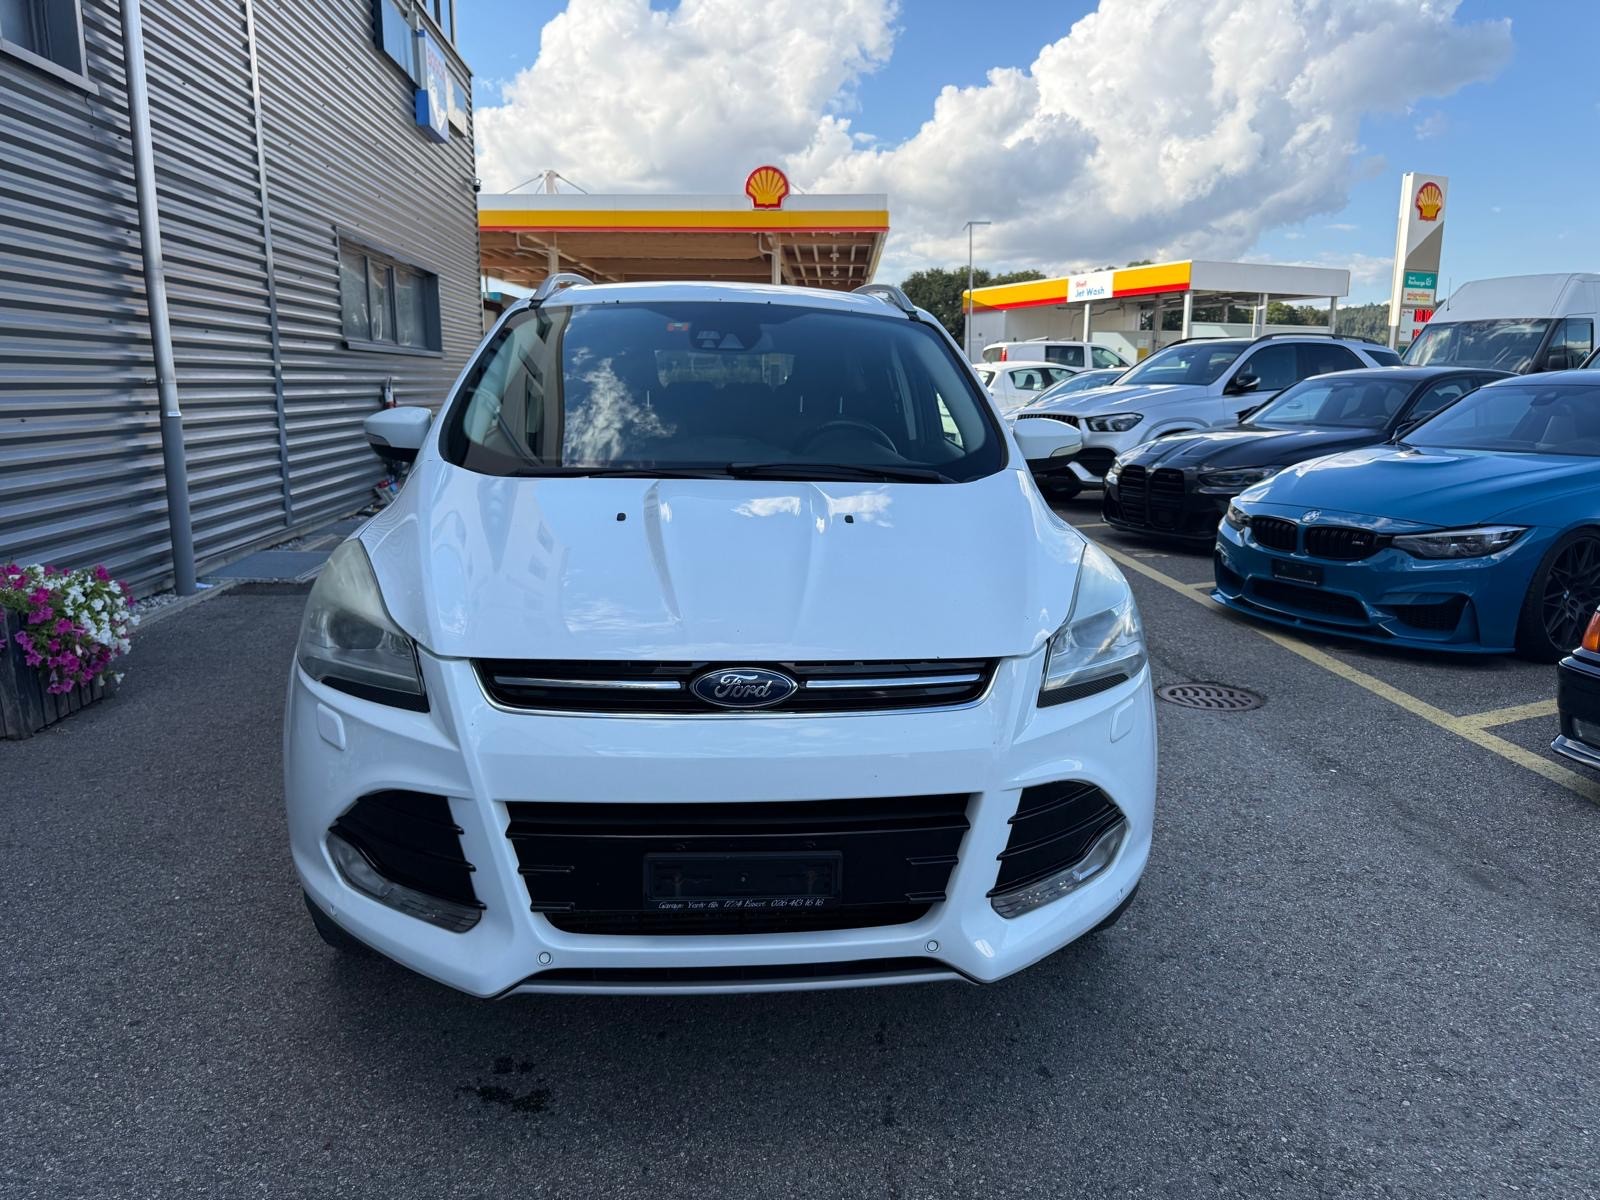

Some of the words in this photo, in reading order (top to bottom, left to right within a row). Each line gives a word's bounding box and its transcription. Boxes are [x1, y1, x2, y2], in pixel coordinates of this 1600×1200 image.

[1075, 289, 1085, 297] Jet
[1086, 286, 1105, 296] Wash
[714, 674, 772, 697] Ford
